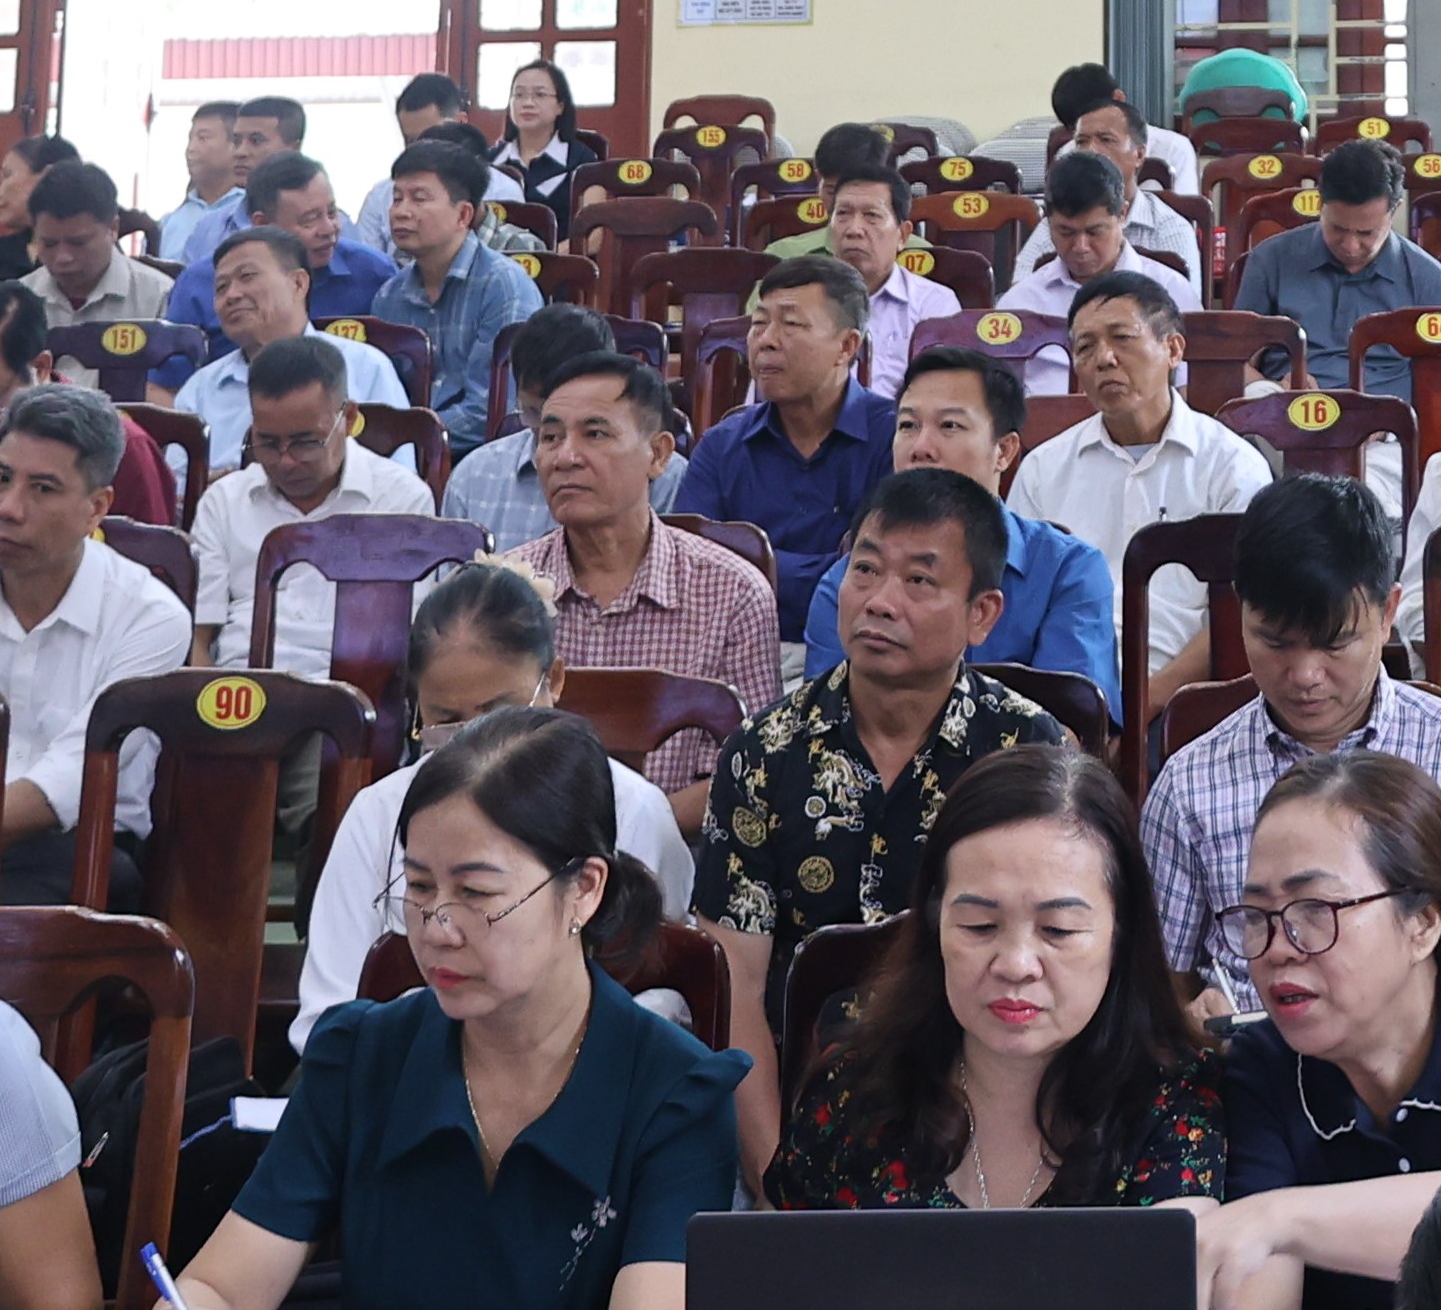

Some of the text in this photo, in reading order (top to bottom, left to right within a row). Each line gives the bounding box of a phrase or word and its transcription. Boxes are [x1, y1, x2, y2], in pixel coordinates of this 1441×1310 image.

[1368, 121, 1381, 135] 51
[627, 165, 644, 180] 68
[787, 163, 804, 178] 58
[949, 161, 966, 177] 75
[1258, 160, 1275, 175] 32
[1423, 159, 1440, 173] 56
[806, 203, 824, 219] 40
[963, 197, 982, 213] 53
[906, 254, 925, 271] 07
[988, 319, 1011, 339] 34
[112, 329, 137, 350] 151
[1301, 399, 1327, 423] 16
[215, 685, 252, 720] 90
